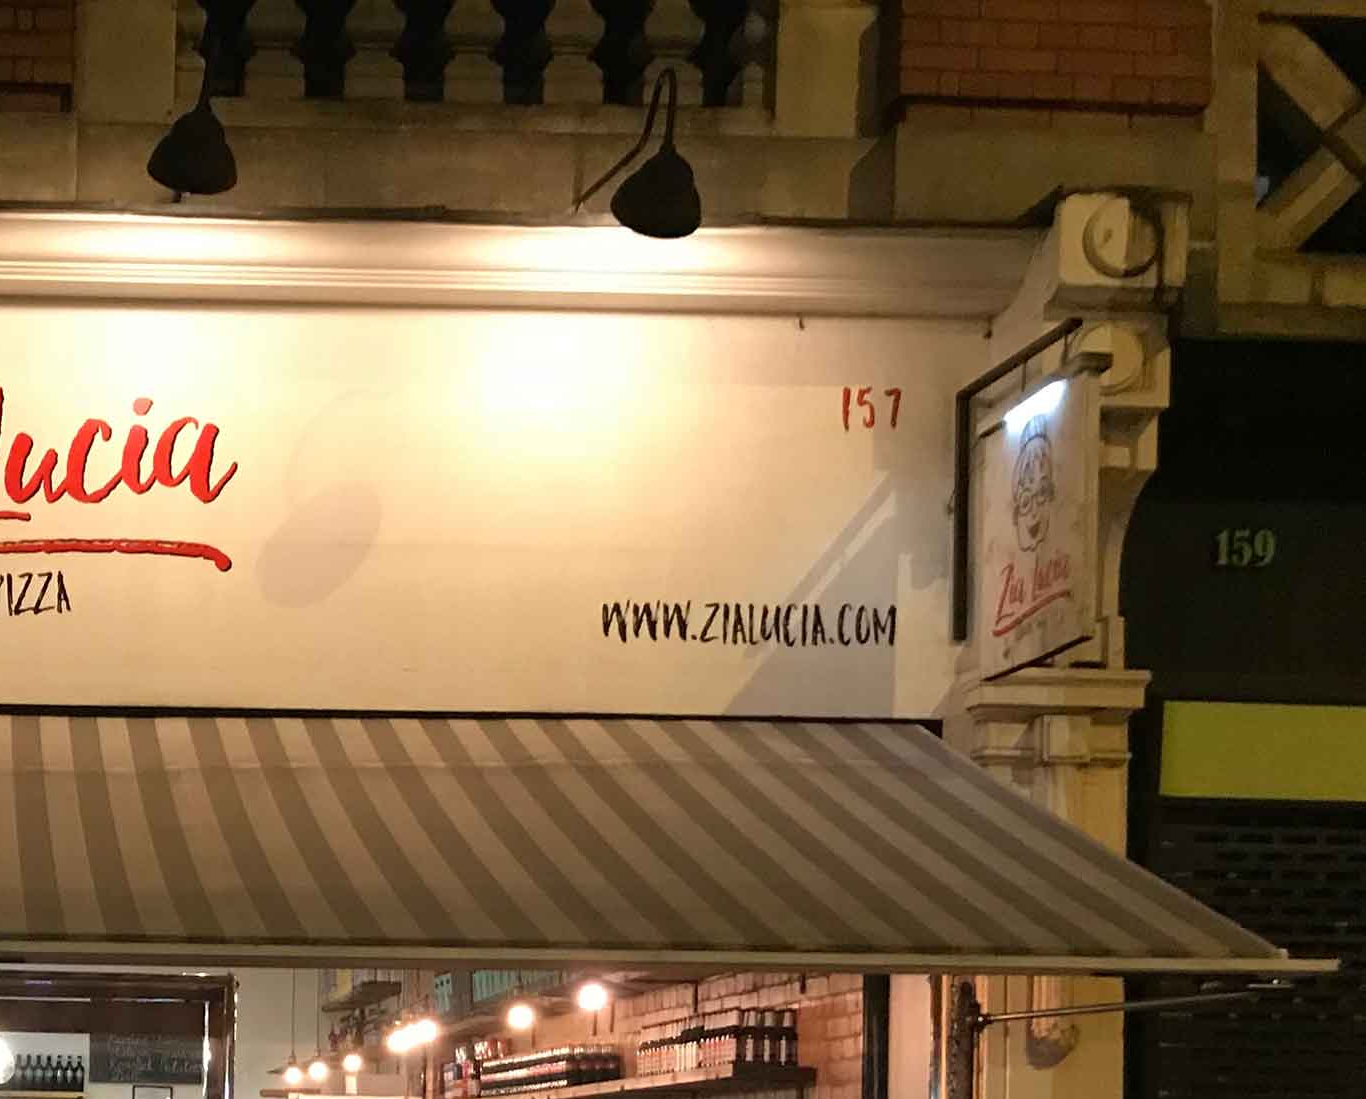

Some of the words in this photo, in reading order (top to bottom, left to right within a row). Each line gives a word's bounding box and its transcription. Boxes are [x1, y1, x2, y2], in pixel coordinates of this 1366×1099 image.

[841, 386, 902, 433] 157
[1214, 527, 1276, 567] 159
[601, 600, 898, 648] WWW.ZIALUCIA.COM
